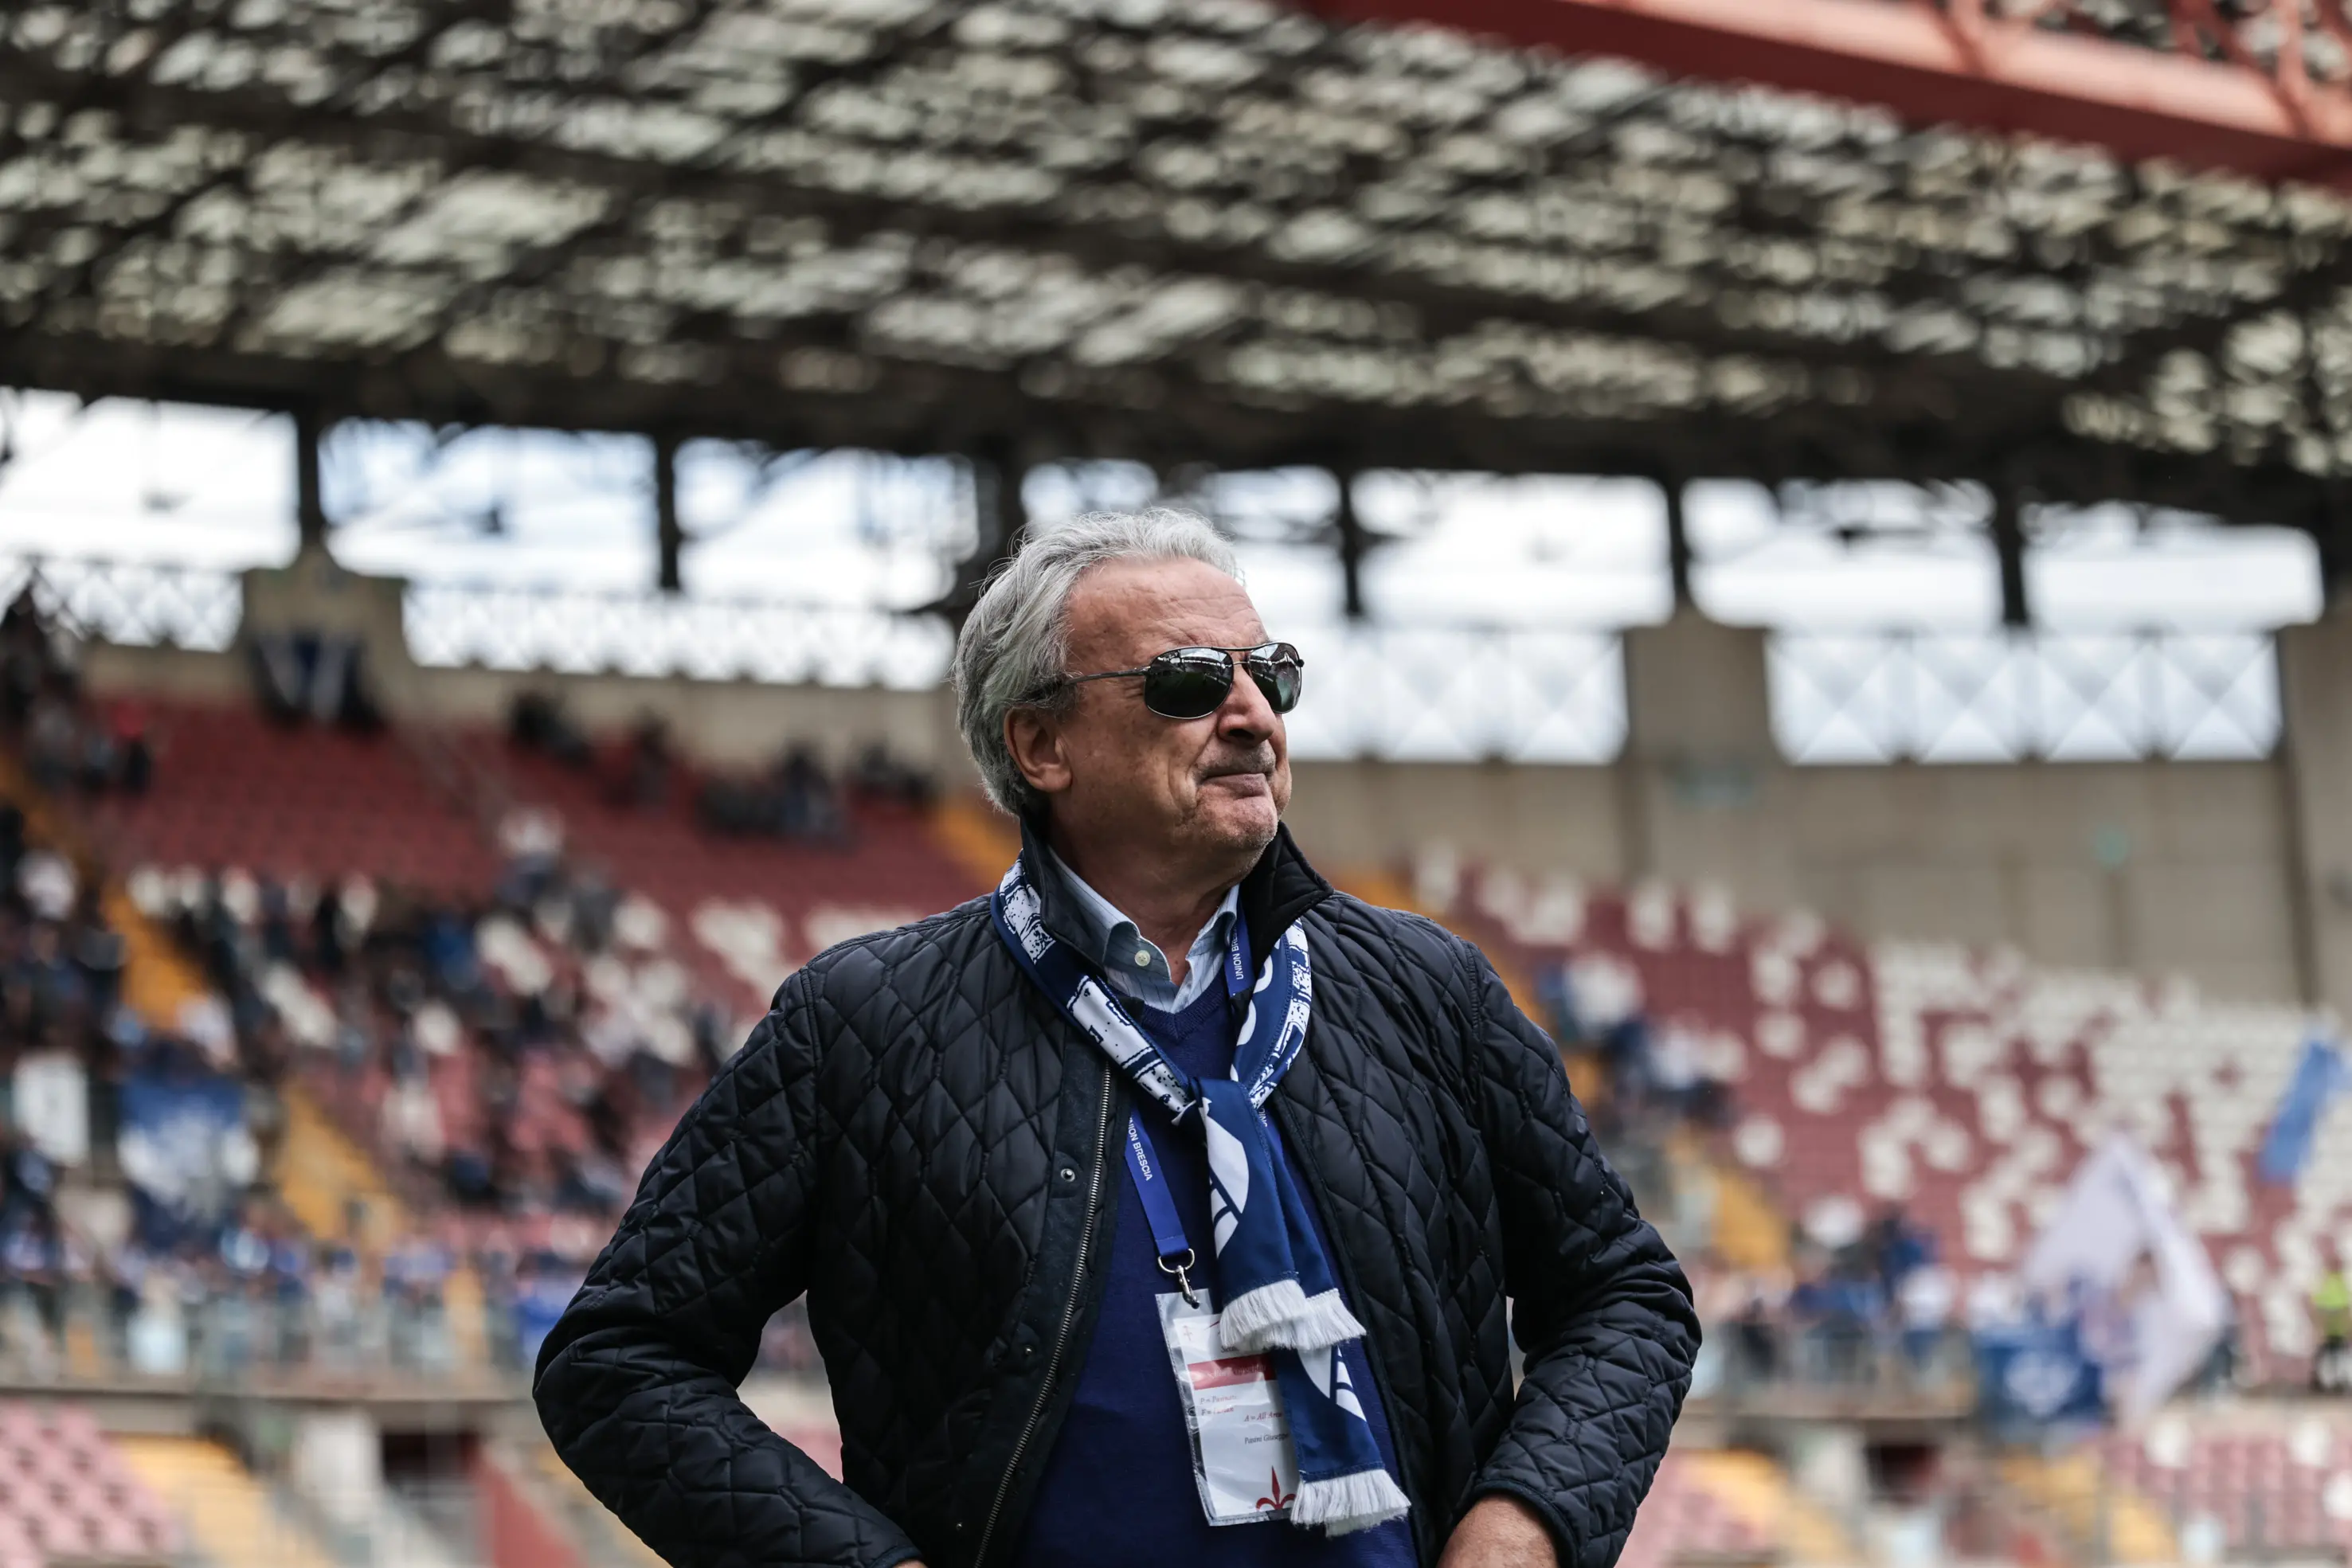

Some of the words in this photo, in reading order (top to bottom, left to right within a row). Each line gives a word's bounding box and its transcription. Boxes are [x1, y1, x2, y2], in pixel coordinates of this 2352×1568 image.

[1232, 952, 1244, 980] UNION
[1128, 1116, 1139, 1142] NION
[1133, 1141, 1153, 1182] BRESCIA
[1257, 1412, 1267, 1421] All
[1244, 1436, 1262, 1445] Pasini
